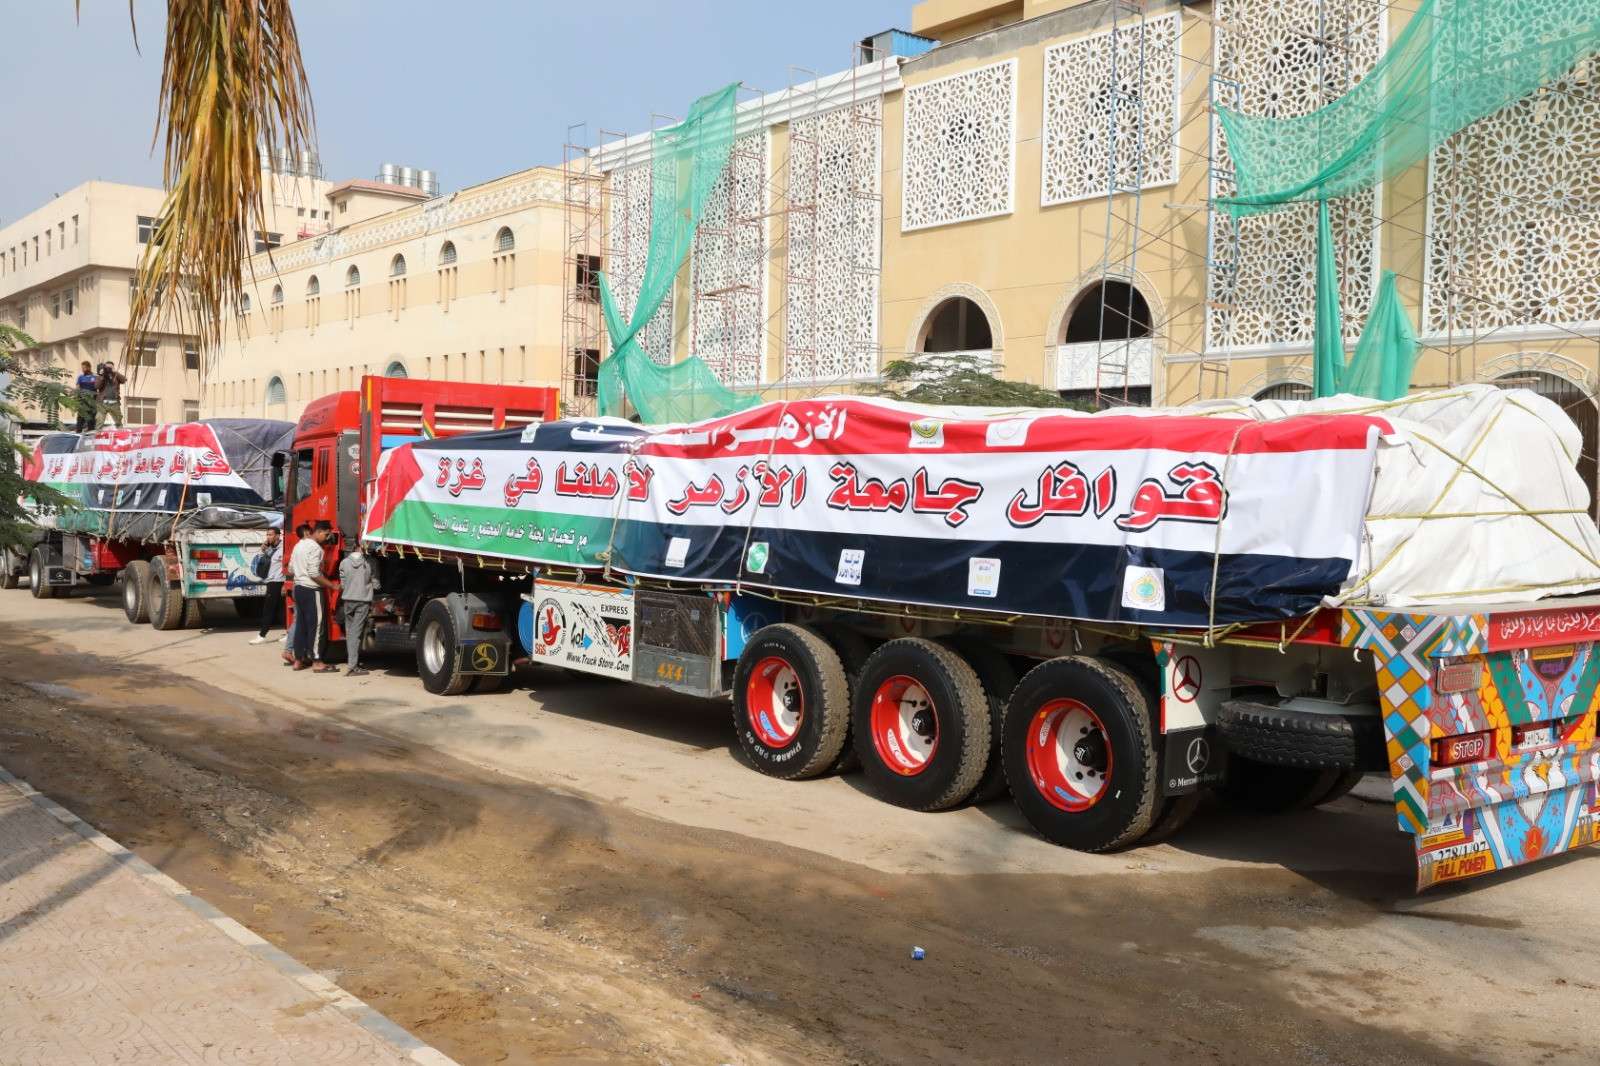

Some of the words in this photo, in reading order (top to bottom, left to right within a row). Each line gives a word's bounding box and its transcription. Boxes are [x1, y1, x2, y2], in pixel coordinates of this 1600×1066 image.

[435, 456, 487, 498] غزة
[503, 456, 544, 508] في
[554, 459, 655, 502] لأهلنا
[666, 459, 806, 515] الأزهر
[827, 461, 984, 528] جامعة
[1006, 460, 1230, 533] قوافل
[450, 515, 470, 536] تنمية
[476, 520, 504, 541] المجتمع
[506, 521, 526, 540] خدمة
[528, 522, 546, 545] لجنة
[547, 527, 576, 549] تحيات
[600, 604, 629, 615] EXPRESS
[534, 643, 547, 656] SGS
[597, 657, 614, 669] Store
[1452, 738, 1484, 760] STOP
[1435, 862, 1457, 880] FULL
[1458, 855, 1487, 875] POWER
